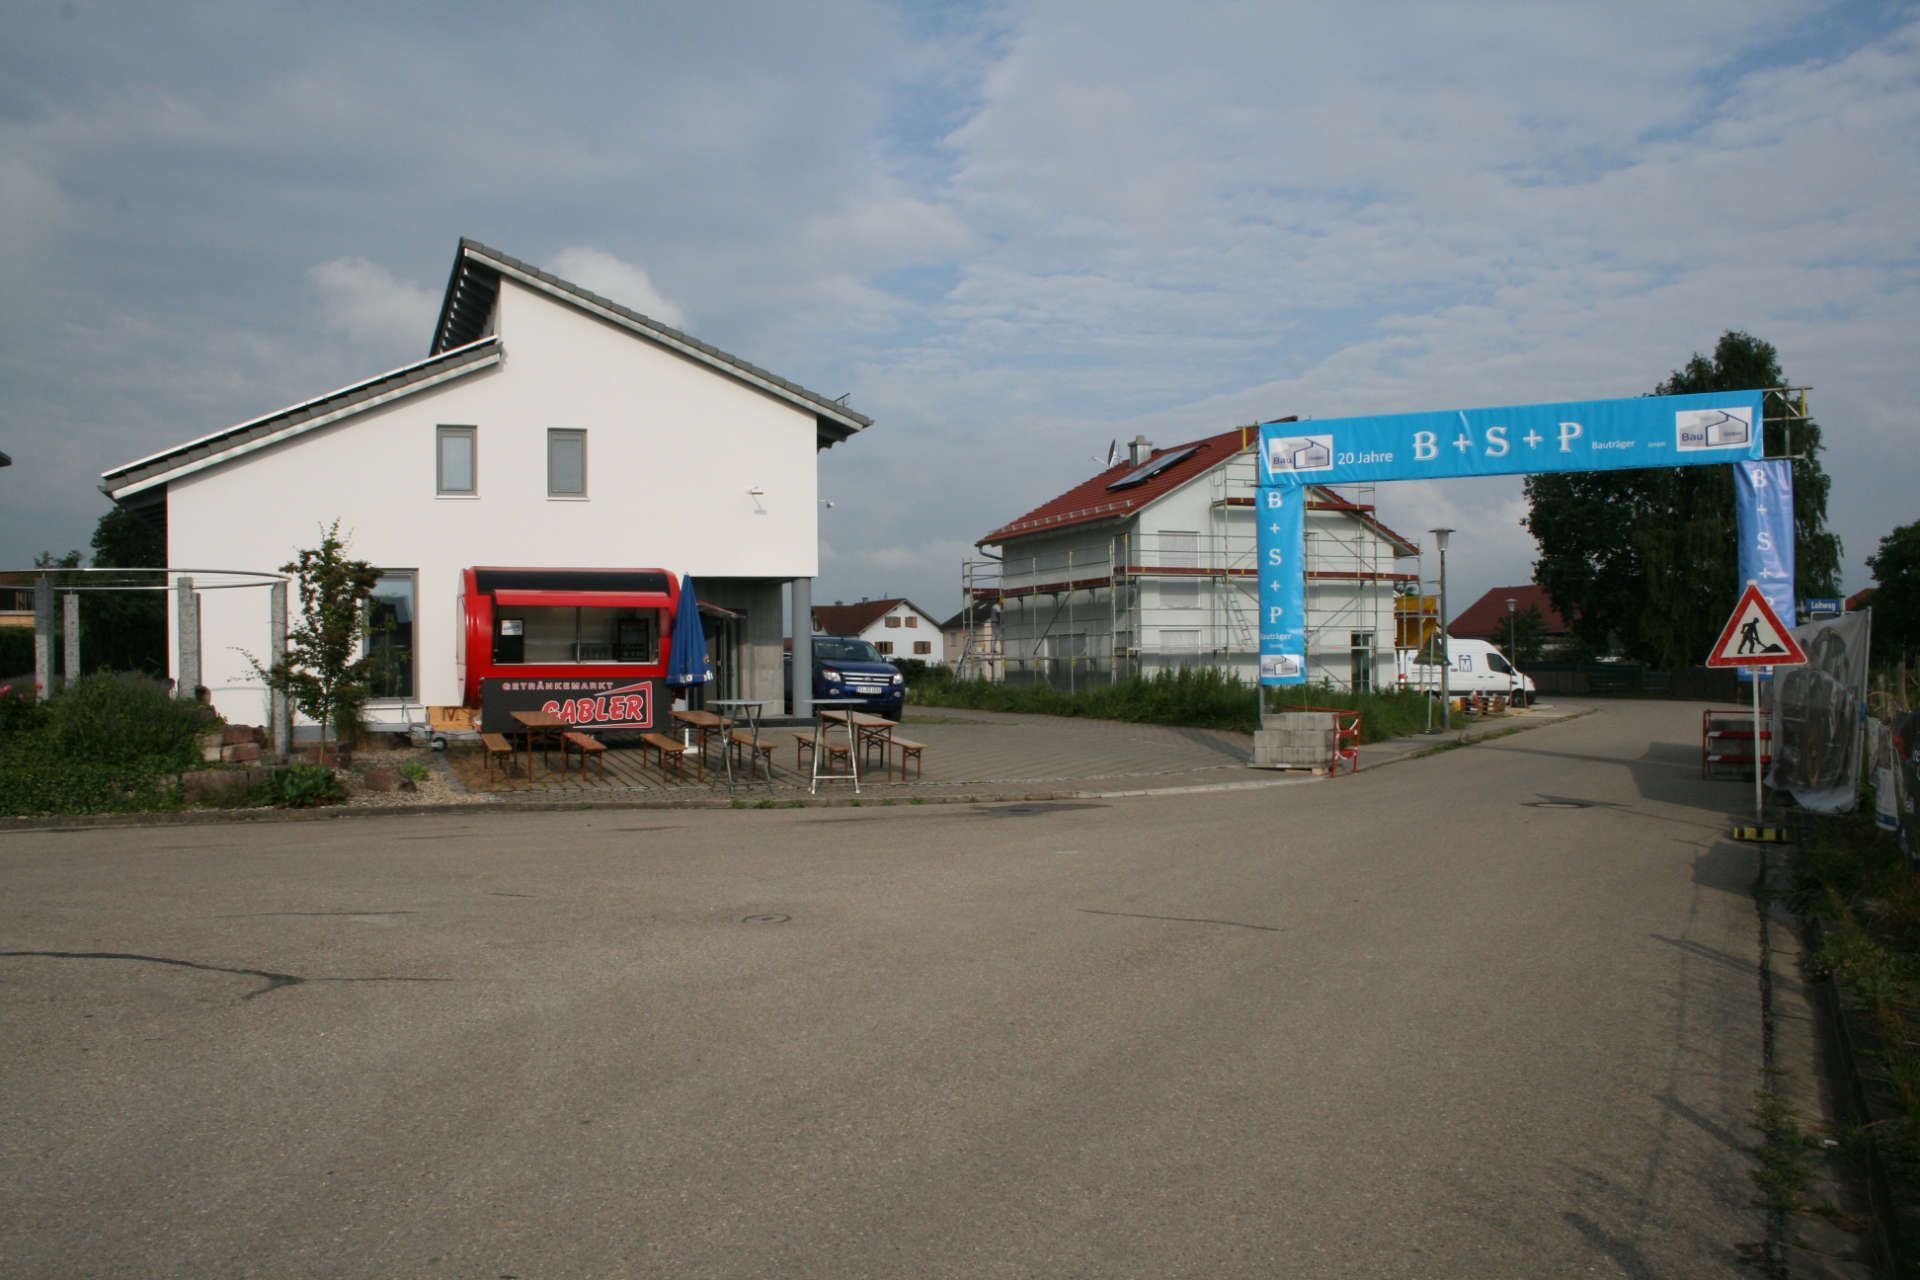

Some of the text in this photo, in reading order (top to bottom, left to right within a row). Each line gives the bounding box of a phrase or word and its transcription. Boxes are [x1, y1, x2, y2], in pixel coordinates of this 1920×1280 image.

[1411, 430, 1440, 462] B
[1484, 426, 1511, 457] S
[1556, 421, 1583, 453] P
[1591, 439, 1637, 450] Bauträger
[1681, 431, 1703, 442] Bau
[1337, 452, 1354, 465] 20
[1357, 450, 1394, 465] Jahre
[1267, 491, 1284, 510] B
[1268, 547, 1283, 566] S
[1270, 605, 1284, 625] P
[502, 680, 614, 691] GETRÄNKEMARKT
[541, 694, 644, 725] GABLER
